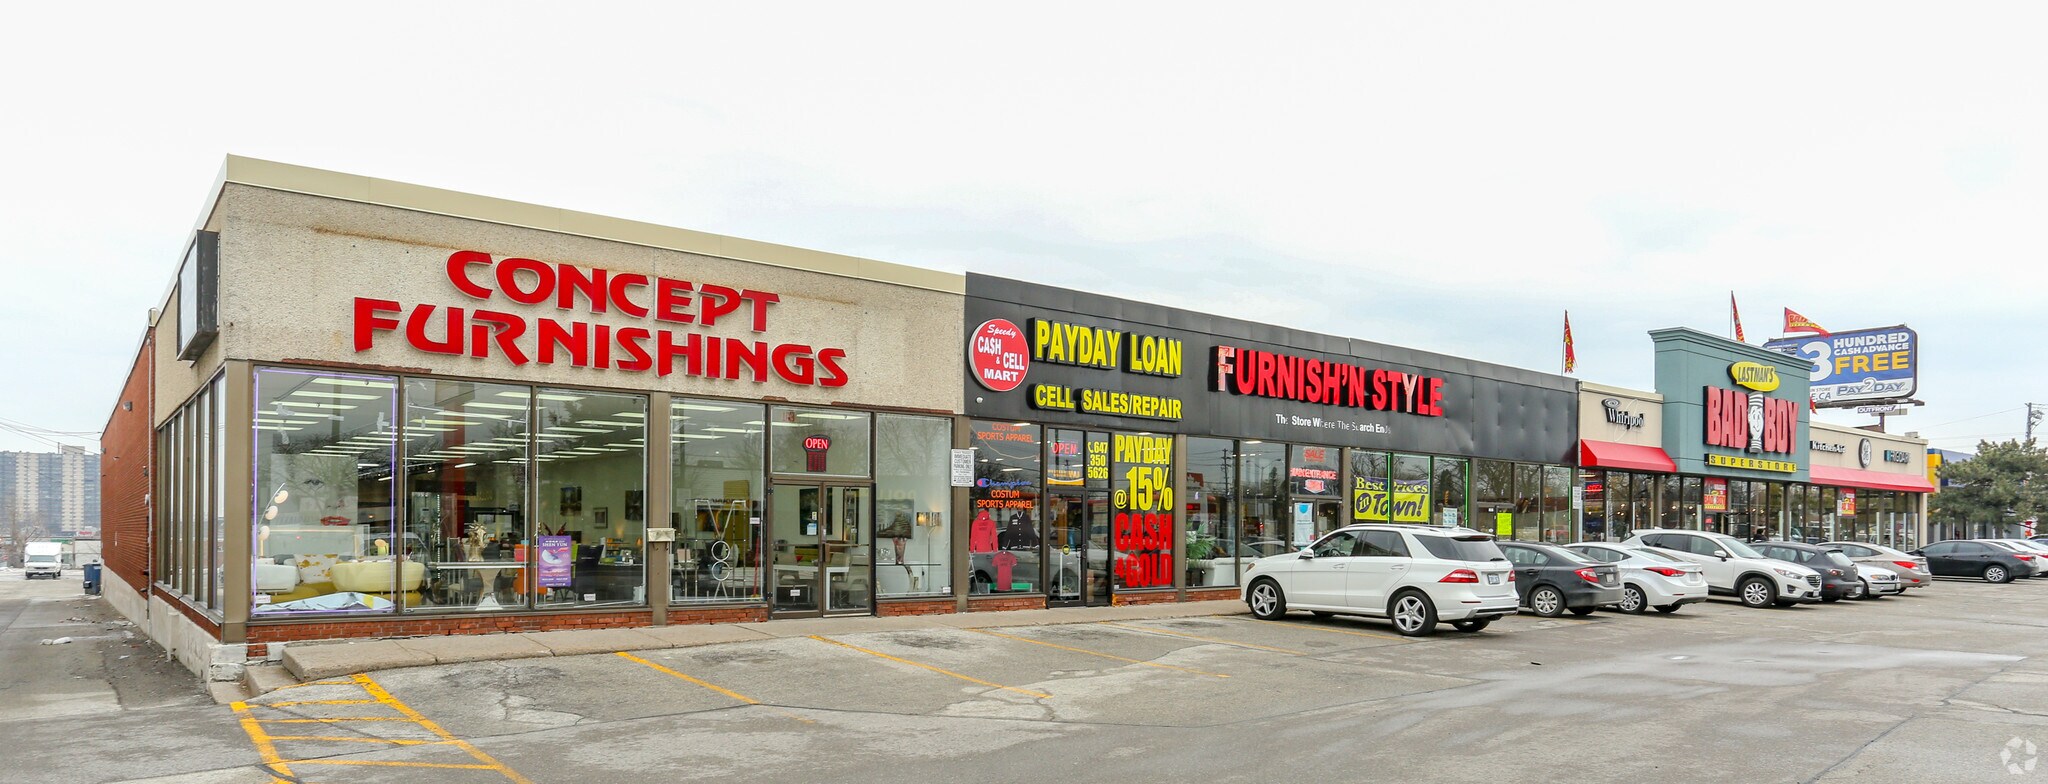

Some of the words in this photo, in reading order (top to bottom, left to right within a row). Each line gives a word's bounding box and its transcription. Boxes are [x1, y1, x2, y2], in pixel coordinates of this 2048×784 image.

[445, 250, 780, 333] CONCEPT
[987, 324, 1017, 338] Speedy
[353, 297, 849, 388] FURNISHINGS
[1036, 319, 1121, 367] PAYDAY
[1131, 334, 1182, 376] LOAN
[1833, 332, 1909, 349] HUNDRED
[1834, 346, 1862, 356] CASH
[1863, 343, 1909, 354] ADVANCE
[995, 356, 1001, 365] &
[1003, 352, 1025, 371] CELL
[1801, 341, 1833, 382] 3
[1835, 351, 1909, 375] FREE
[984, 369, 1019, 382] MART
[1217, 345, 1365, 407] FURNISH'N
[1372, 369, 1444, 417] STYLE
[1738, 365, 1775, 384] LASTMAN'S
[1035, 384, 1075, 409] CELL
[1082, 389, 1182, 419] SALES/REPAIR
[1291, 415, 1312, 427] Store
[1337, 420, 1350, 431] The
[1706, 386, 1748, 449] BAD
[1764, 396, 1799, 455] BOY
[805, 438, 828, 449] OPEN
[977, 432, 1004, 441] SPORTS
[1005, 433, 1034, 443] APPAREL
[1052, 442, 1077, 455] OPEN
[1093, 442, 1108, 454] 647
[1114, 434, 1173, 465] PAYDAY
[1090, 454, 1106, 467] 350
[1710, 455, 1797, 472] SUPERSTORE
[1087, 467, 1109, 479] 5626
[1114, 489, 1127, 509] @
[1126, 466, 1173, 511] 15%
[1355, 477, 1384, 491] Best
[991, 490, 1020, 499] COSTUM
[977, 499, 1004, 509] SPORTS
[1005, 500, 1034, 509] APPAREL
[1372, 494, 1426, 518] Town!
[1114, 512, 1173, 551] CASH
[1125, 551, 1173, 588] GOLD
